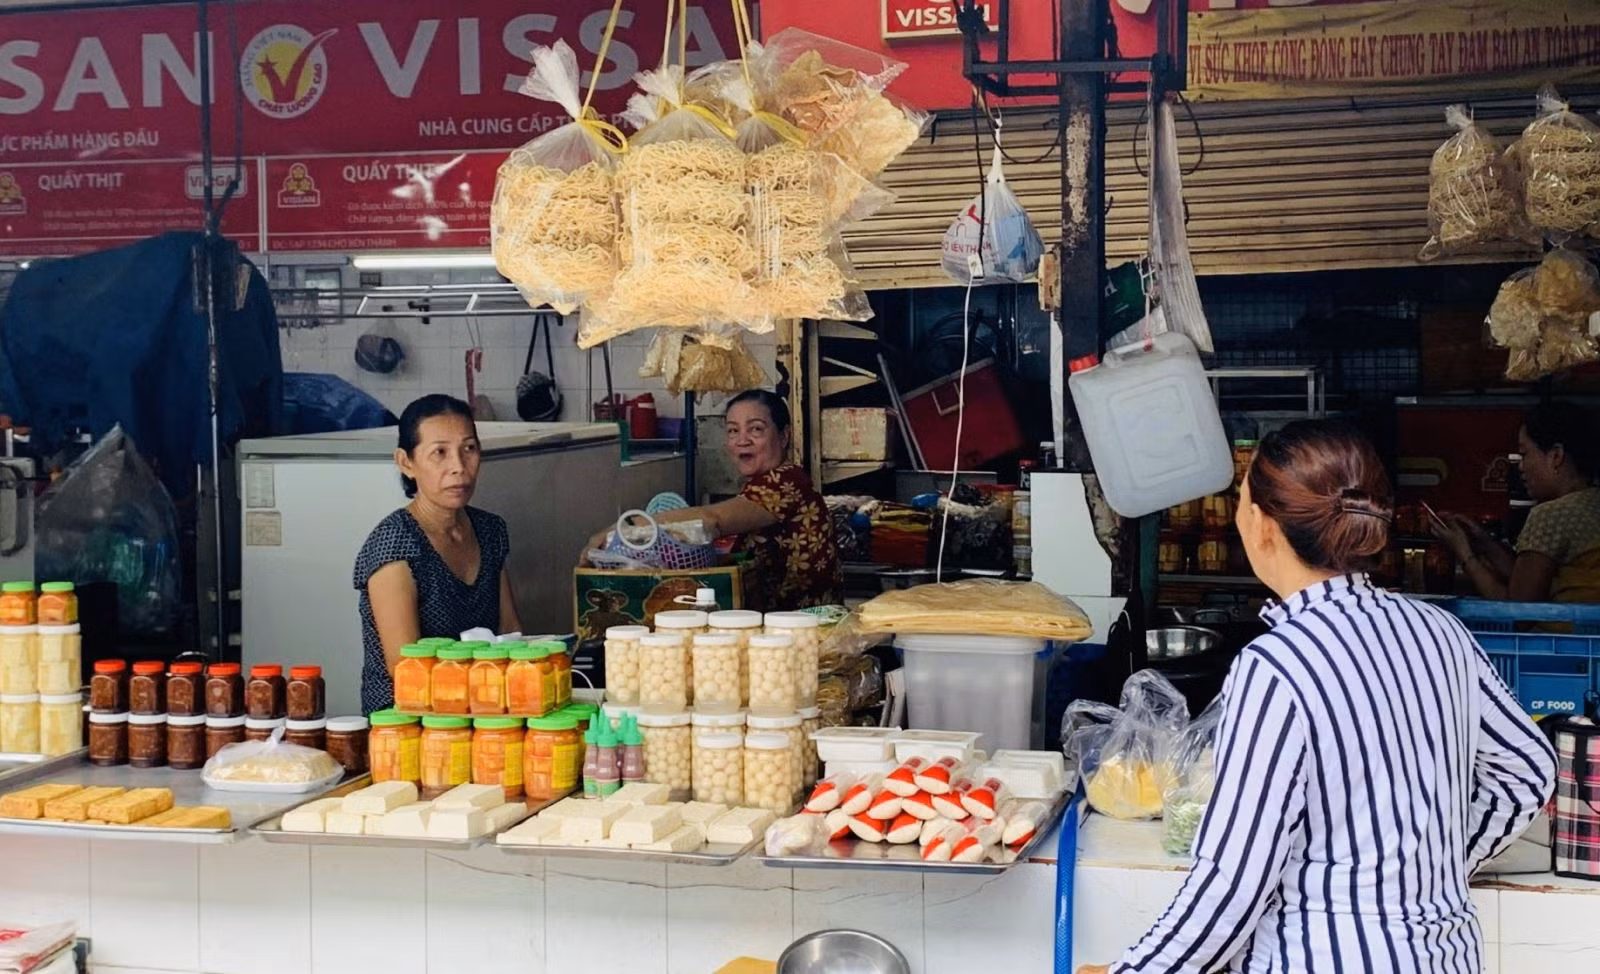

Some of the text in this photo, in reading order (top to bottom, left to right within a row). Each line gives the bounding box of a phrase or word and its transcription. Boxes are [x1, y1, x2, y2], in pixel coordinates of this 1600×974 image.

[896, 4, 991, 27] VISS
[357, 3, 759, 99] VISSA
[1380, 33, 1426, 77] CHUNG
[1429, 31, 1455, 74] TAY
[419, 117, 457, 136] NHÀ
[461, 116, 513, 134] CUNG
[517, 112, 554, 132] CẤP
[73, 130, 120, 149] HÀNG
[1531, 701, 1576, 711] CP FOOD
